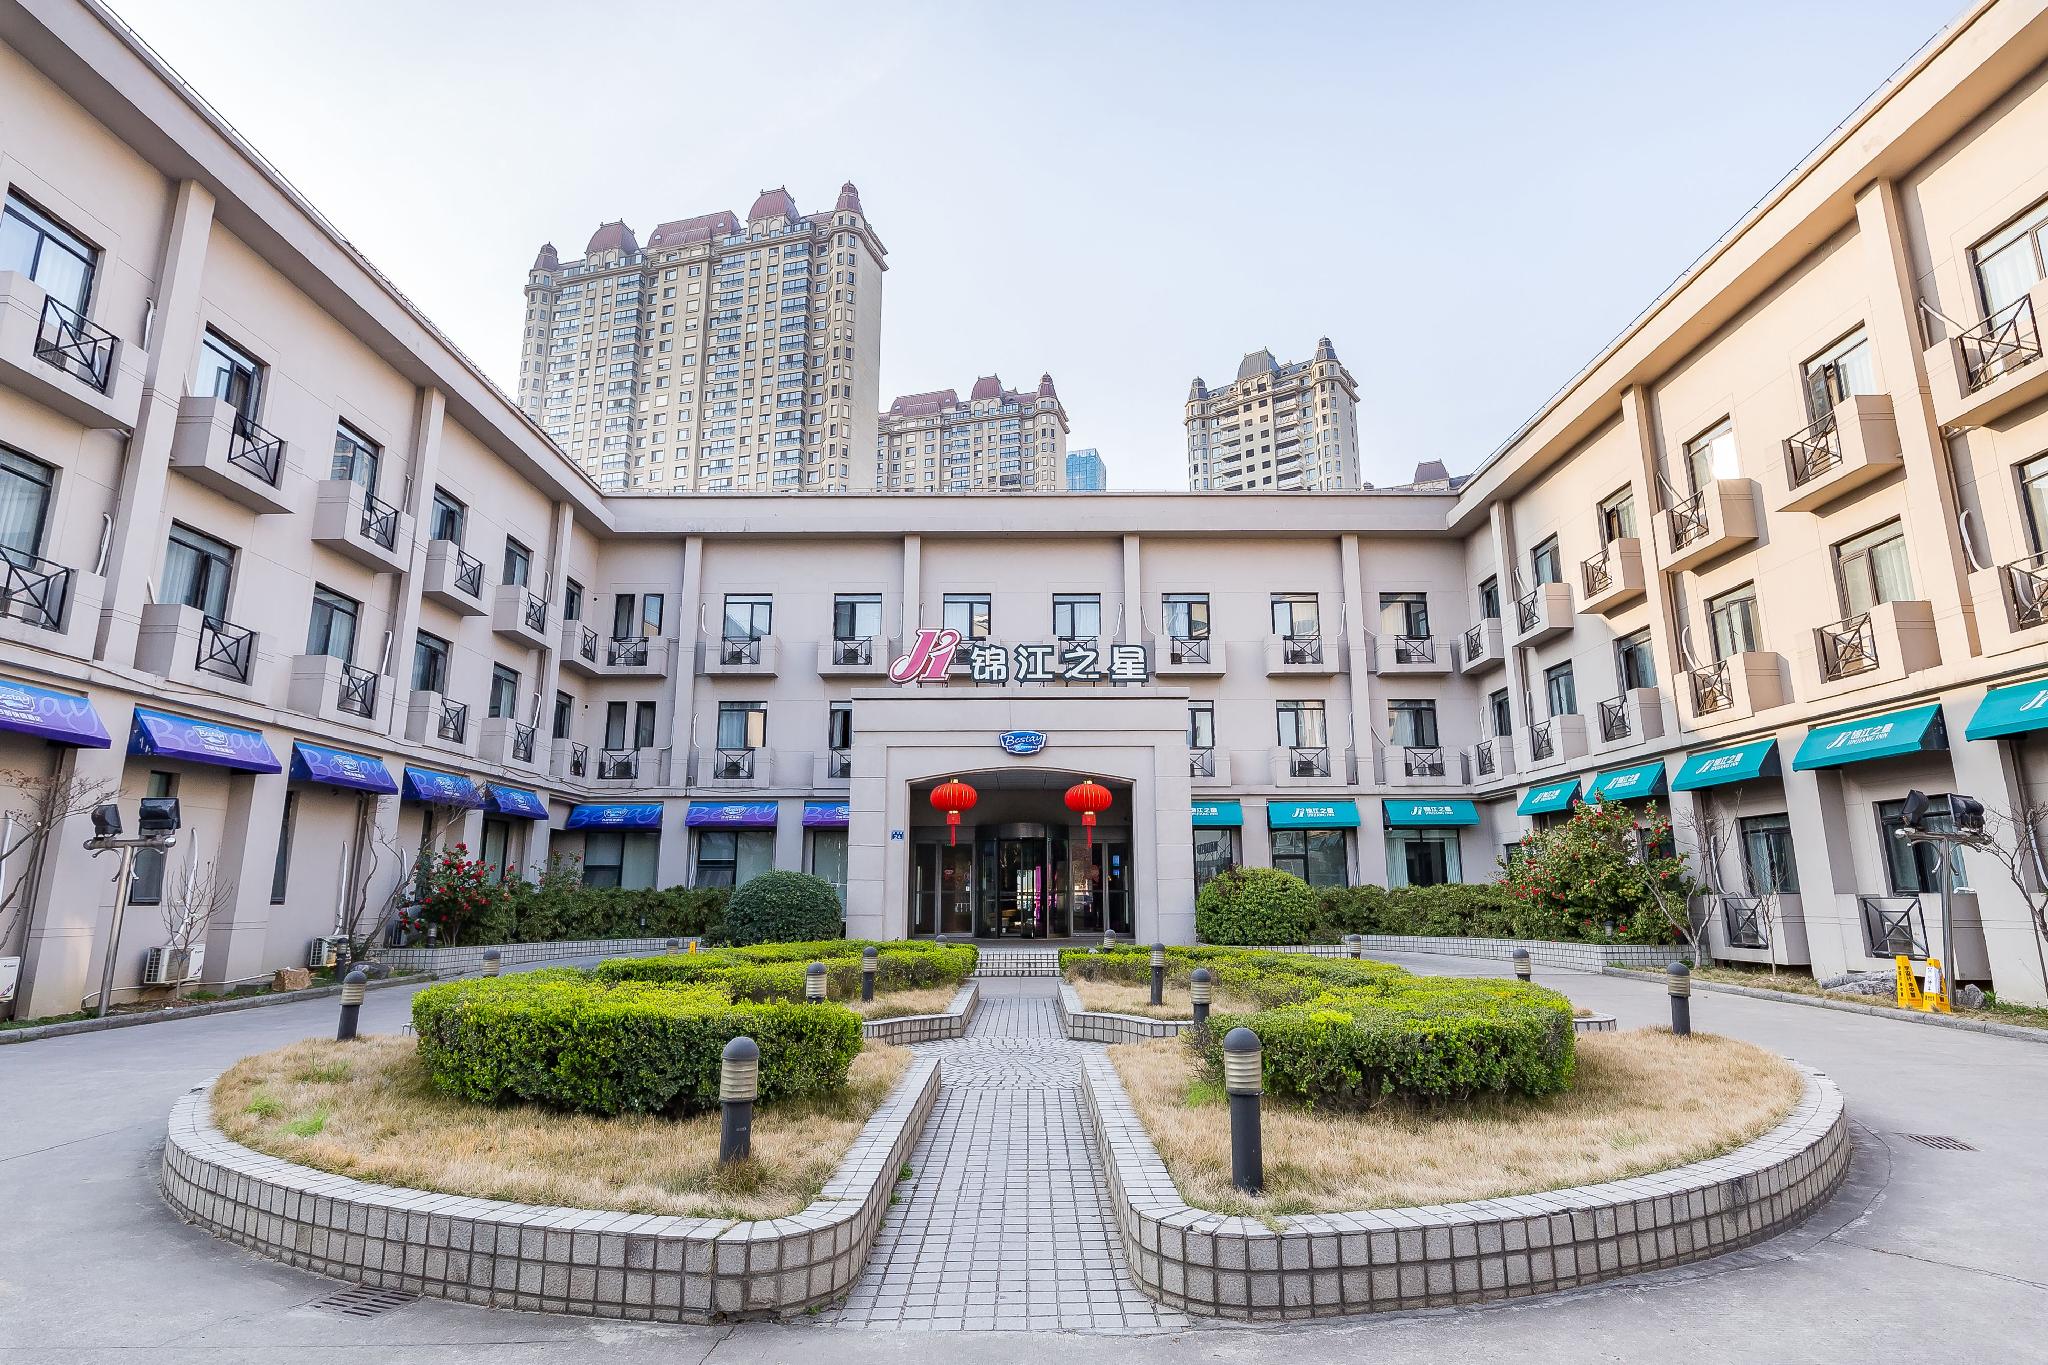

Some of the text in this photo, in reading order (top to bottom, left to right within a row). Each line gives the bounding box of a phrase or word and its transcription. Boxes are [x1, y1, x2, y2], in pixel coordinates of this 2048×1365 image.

[970, 644, 1149, 683] 锦江之星
[1004, 735, 1043, 745] Bestay
